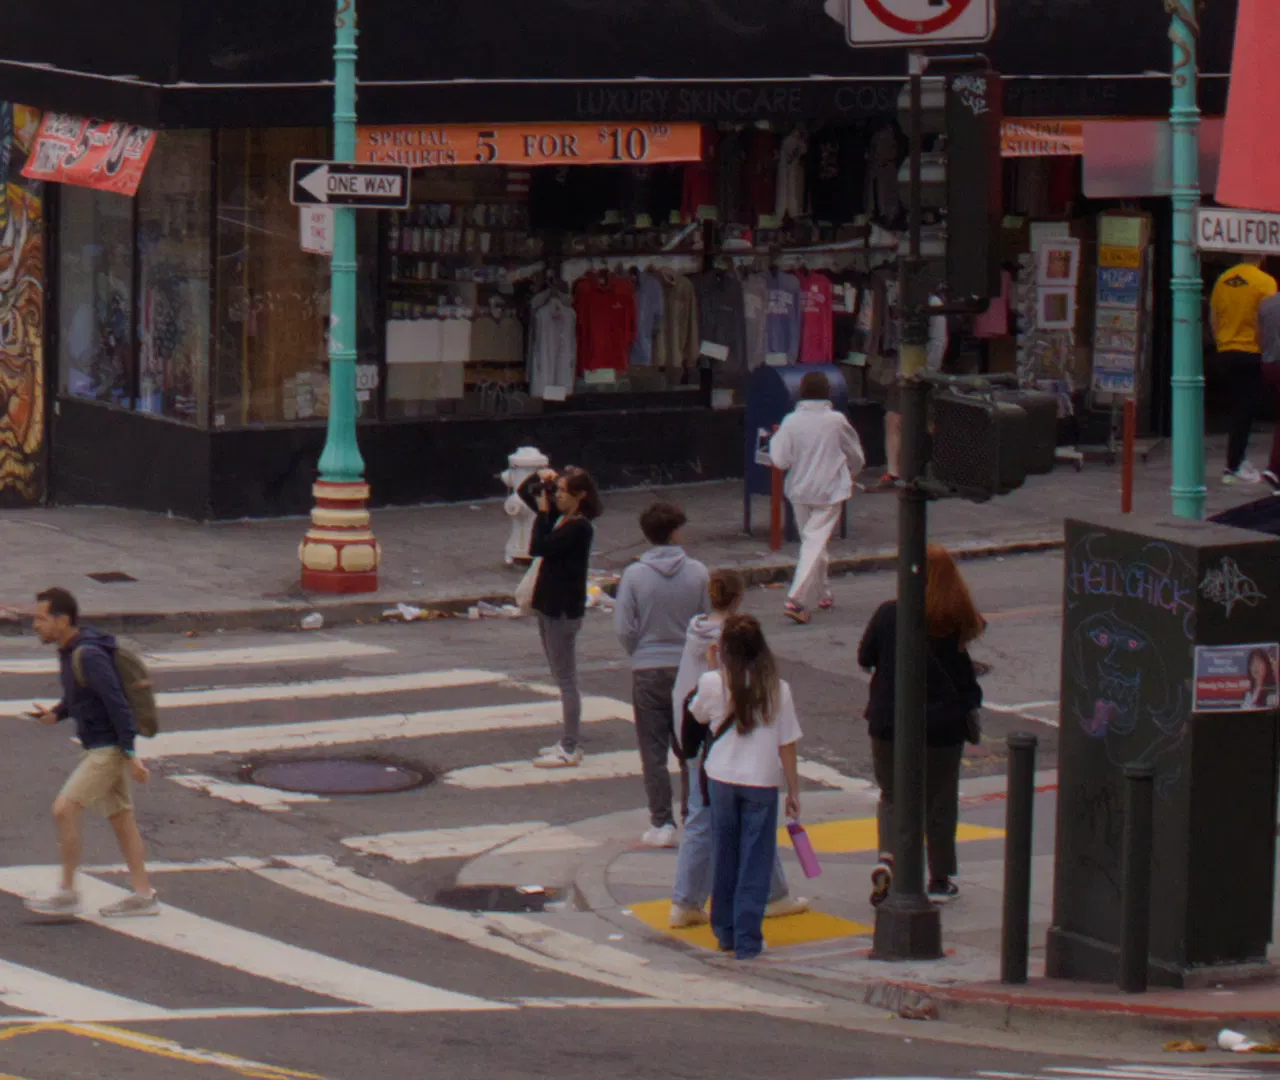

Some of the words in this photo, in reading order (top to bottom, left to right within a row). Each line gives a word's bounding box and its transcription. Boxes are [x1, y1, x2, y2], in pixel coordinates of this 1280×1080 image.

[368, 129, 451, 146] SPECIAL
[475, 130, 498, 163] 5
[522, 134, 580, 158] FOR
[367, 149, 457, 165] T-SHIRTS
[327, 175, 358, 193] ONE
[363, 176, 396, 193] WAY
